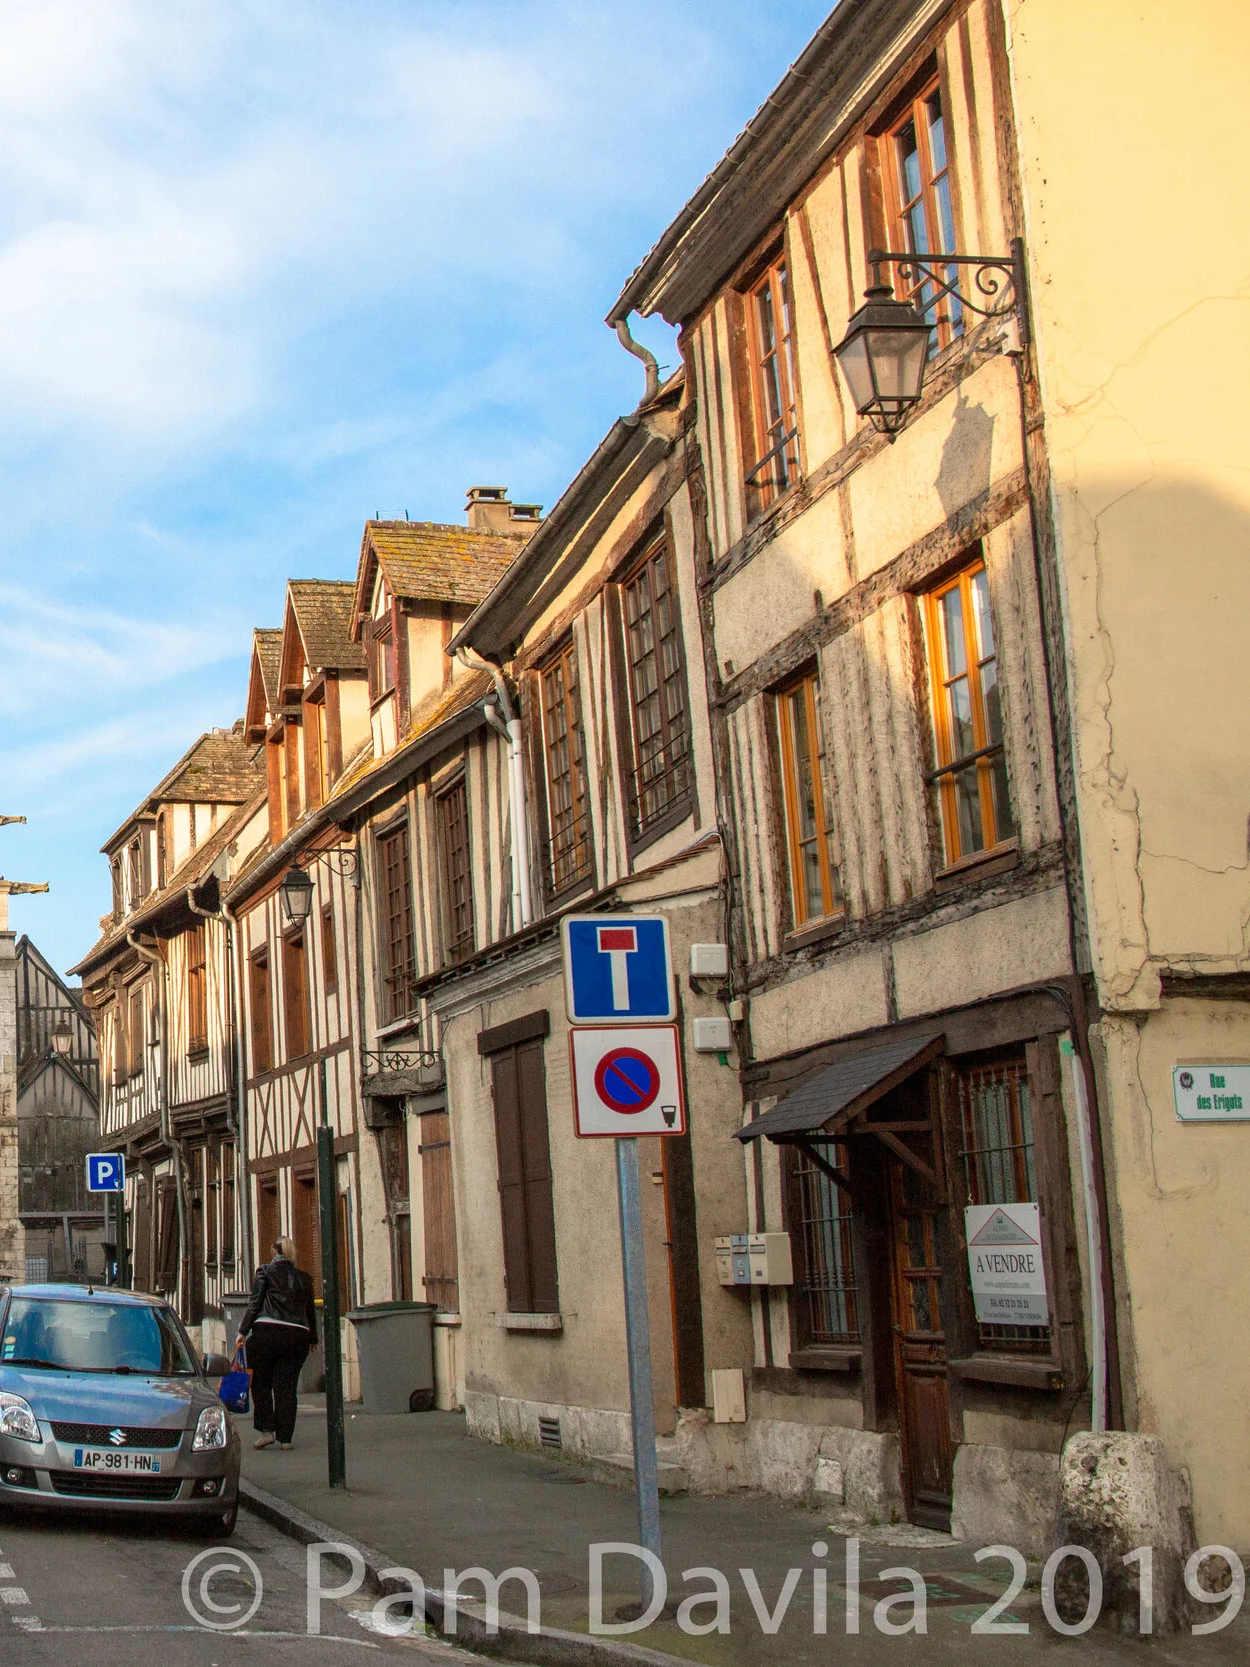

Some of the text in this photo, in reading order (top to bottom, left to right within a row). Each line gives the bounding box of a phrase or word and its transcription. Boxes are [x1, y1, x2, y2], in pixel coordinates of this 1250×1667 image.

[1209, 1073, 1226, 1088] Rue
[1197, 1094, 1243, 1112] des Erigots
[97, 1161, 114, 1185] P
[976, 1254, 1036, 1273] A VENDRE
[84, 1452, 151, 1470] AP-981-HN
